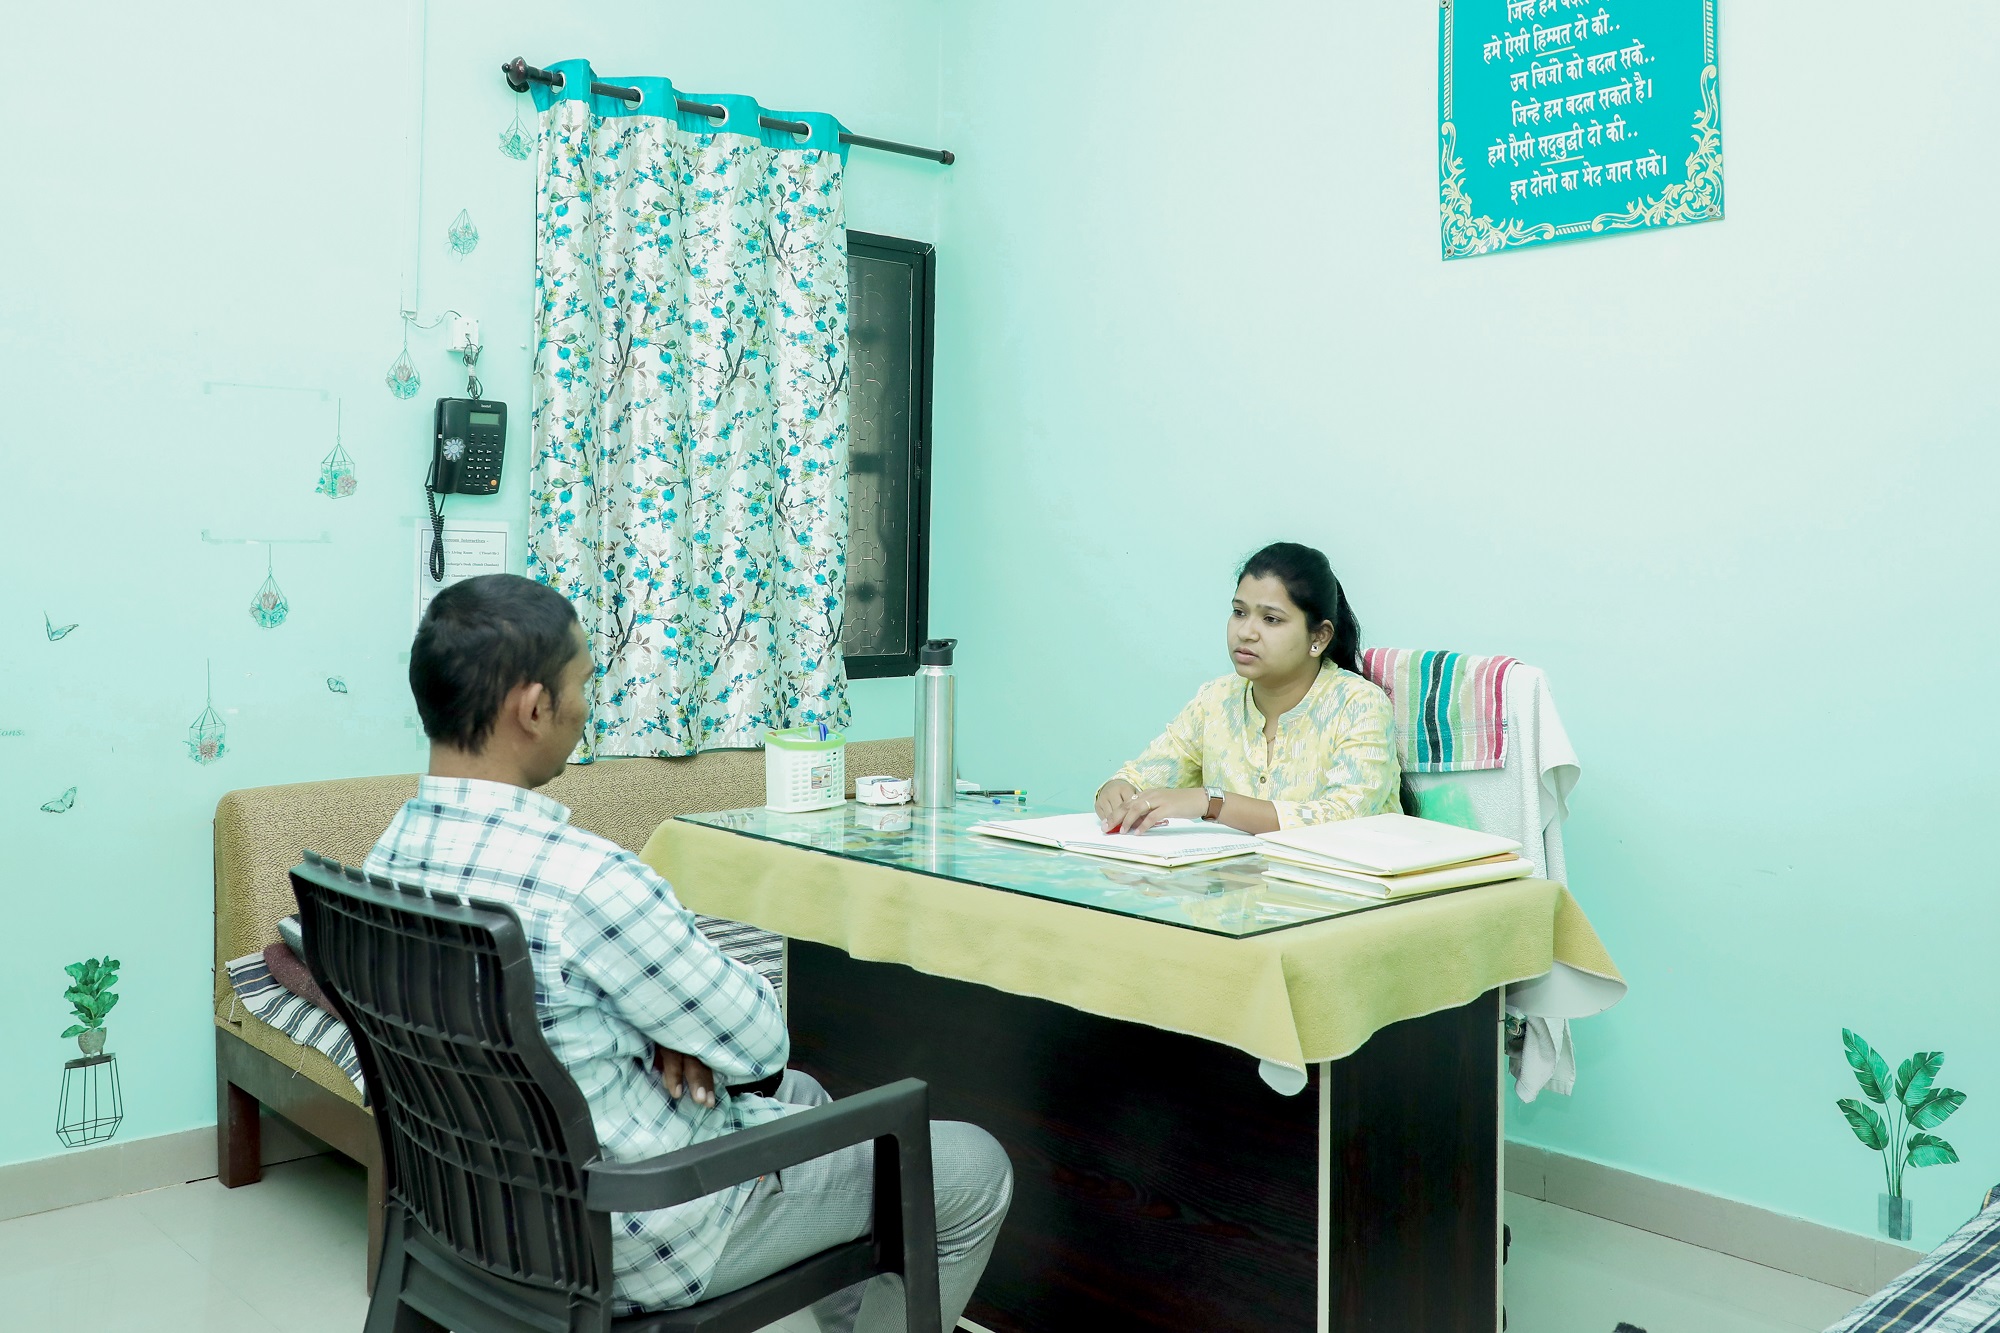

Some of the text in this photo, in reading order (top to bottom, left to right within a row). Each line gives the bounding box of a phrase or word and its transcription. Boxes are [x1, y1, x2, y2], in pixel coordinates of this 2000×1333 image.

[1483, 35, 1502, 64] हमे
[1504, 27, 1530, 62] ऐसी
[1533, 24, 1572, 51] हिम्मत
[1574, 14, 1589, 41] दो
[1510, 71, 1529, 91] उन
[1566, 53, 1584, 80] को
[1587, 51, 1617, 75] बदल
[1512, 97, 1541, 127] जिन्हे
[1544, 98, 1563, 122] हम
[1566, 91, 1596, 115] बदल
[1598, 78, 1632, 110] सकते
[1488, 138, 1507, 168] हमे
[1587, 119, 1603, 147] दो
[1510, 179, 1528, 205] इन
[1530, 168, 1558, 197] दोनो
[1561, 170, 1579, 191] का
[1582, 161, 1603, 186] भेद
[1605, 160, 1633, 183] जान
